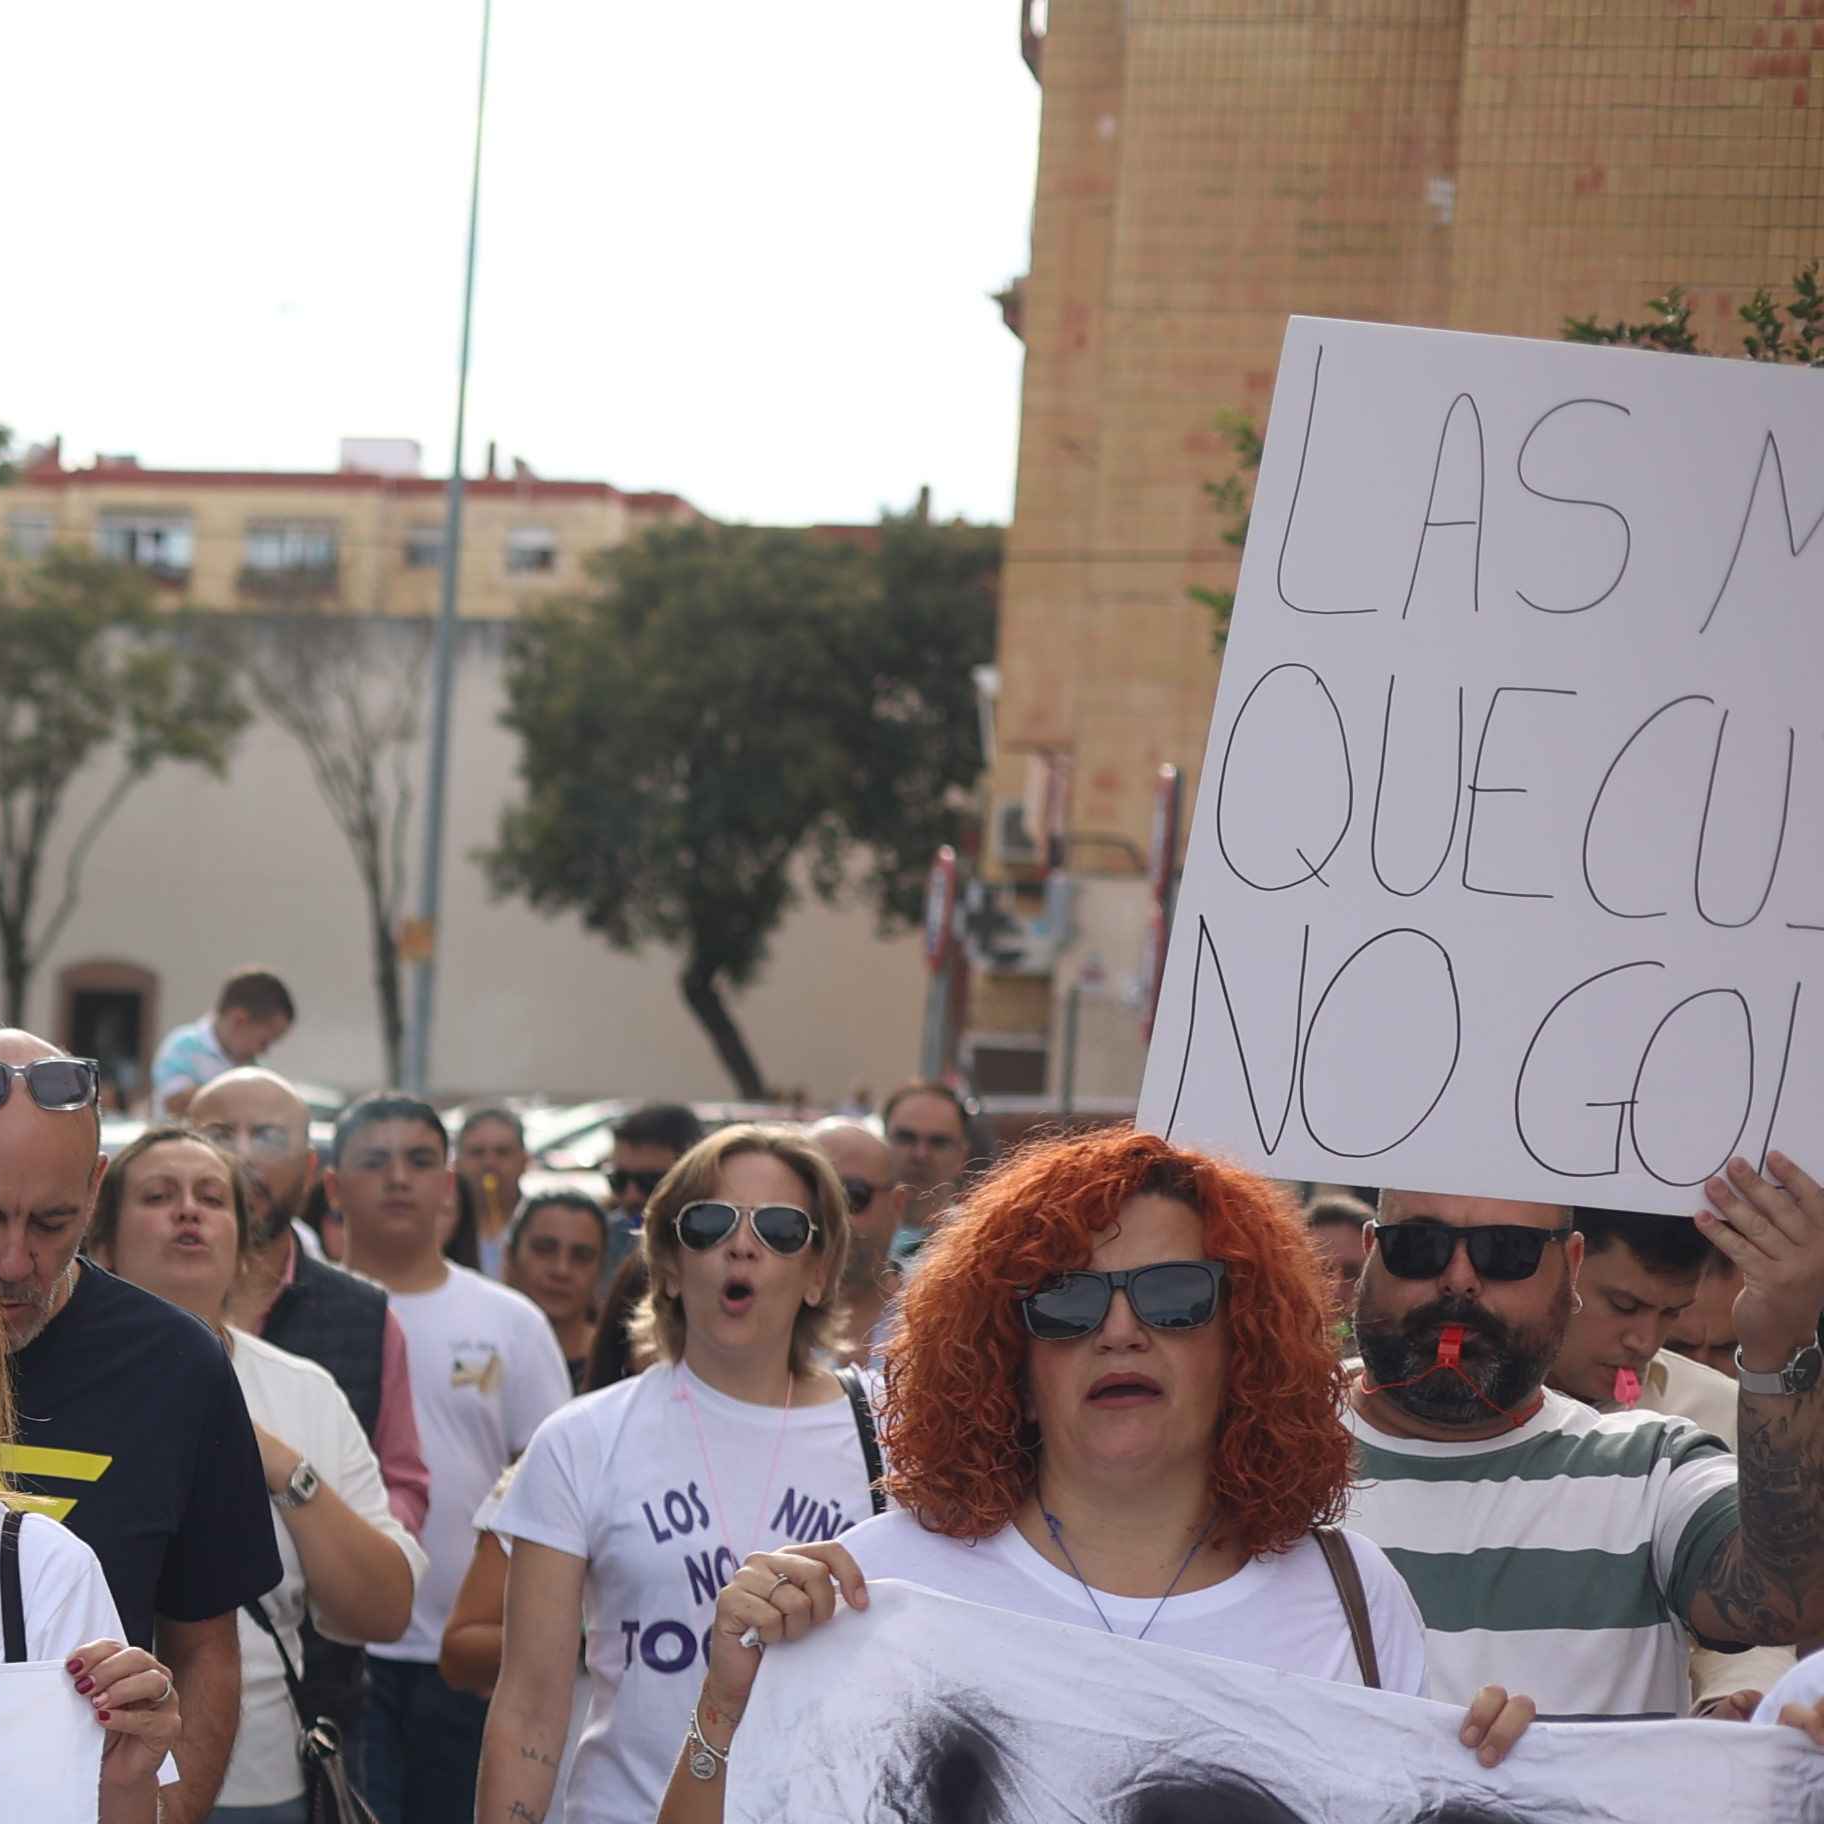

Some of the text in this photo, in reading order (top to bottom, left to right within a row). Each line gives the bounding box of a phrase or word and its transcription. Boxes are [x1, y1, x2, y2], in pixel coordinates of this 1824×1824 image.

[1277, 344, 1632, 619] LAS
[1582, 694, 1824, 932] CU
[1165, 914, 1460, 1158] NO
[642, 1480, 710, 1544] LOS
